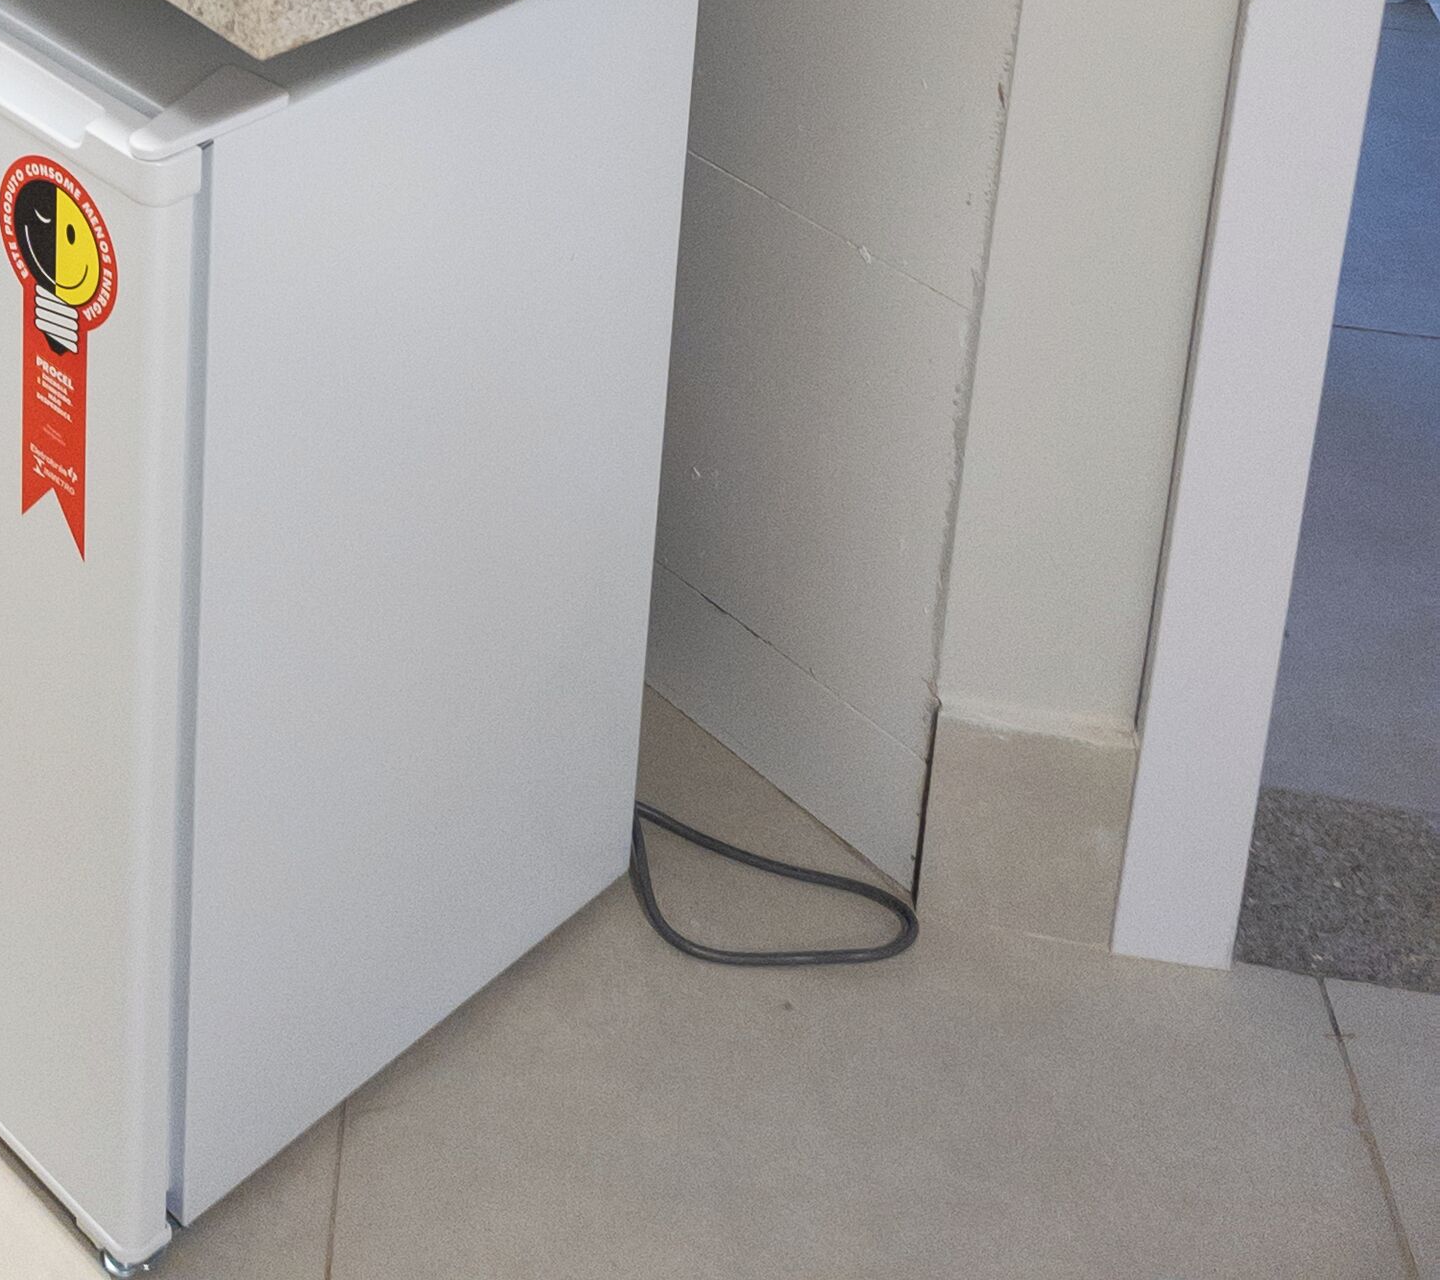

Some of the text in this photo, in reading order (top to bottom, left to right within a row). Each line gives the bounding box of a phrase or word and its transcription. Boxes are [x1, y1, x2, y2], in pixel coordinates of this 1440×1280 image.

[3, 163, 112, 321] ESTE PRODUTO CONSOME MENOS ENERGIA
[35, 354, 74, 391] PROCEL
